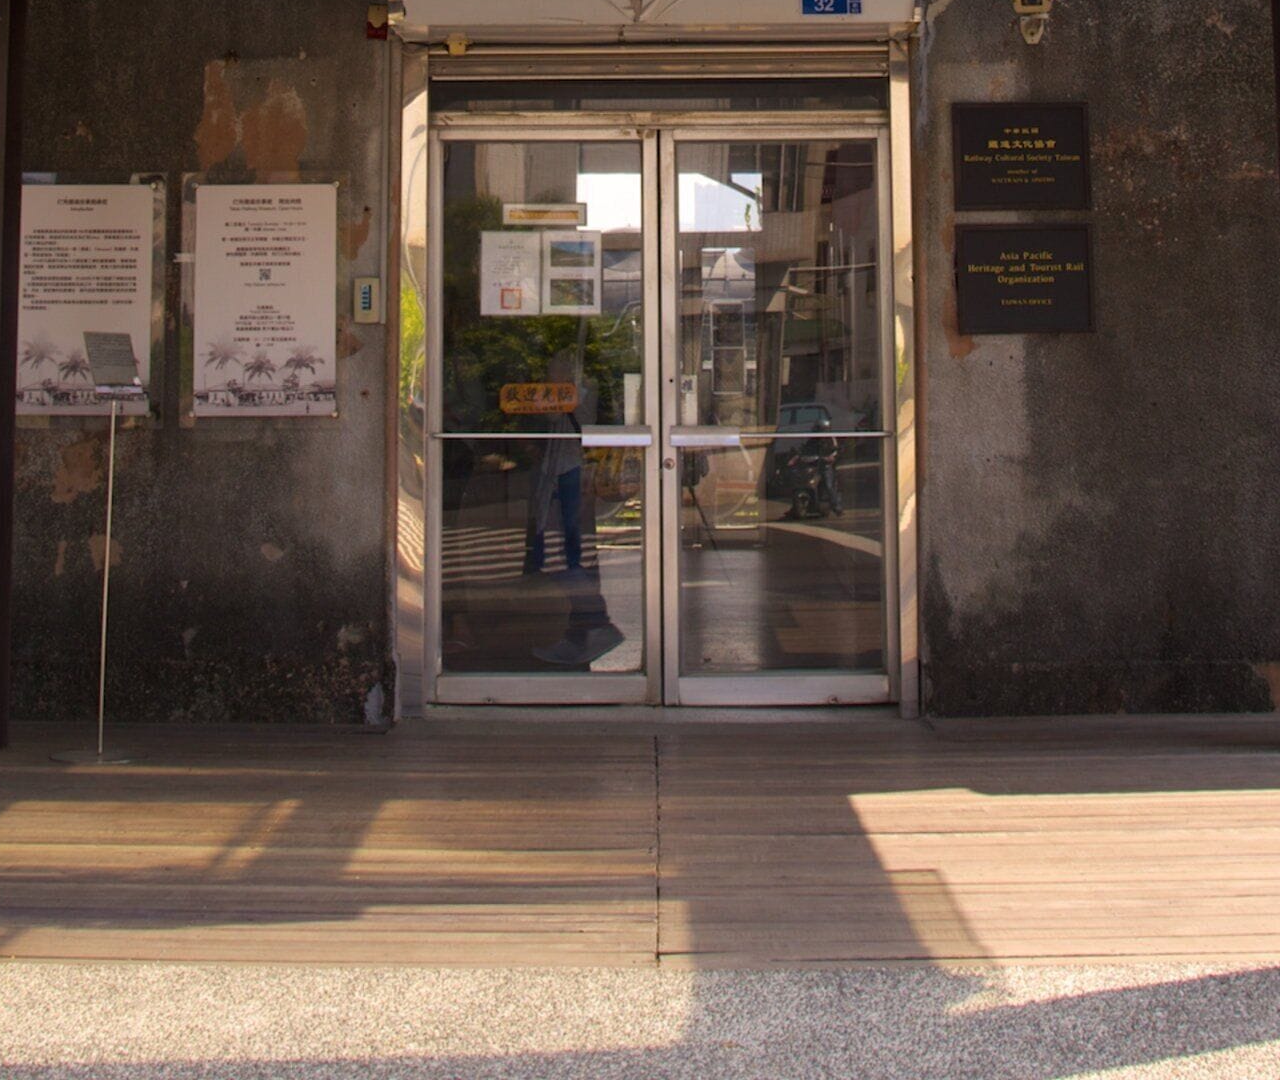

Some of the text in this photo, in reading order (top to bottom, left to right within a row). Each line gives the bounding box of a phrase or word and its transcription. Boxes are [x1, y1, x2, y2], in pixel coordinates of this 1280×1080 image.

[1023, 251, 1053, 260] Pacific
[968, 263, 1084, 273] Heritage and Tourist Rail
[997, 275, 1055, 285] Organization
